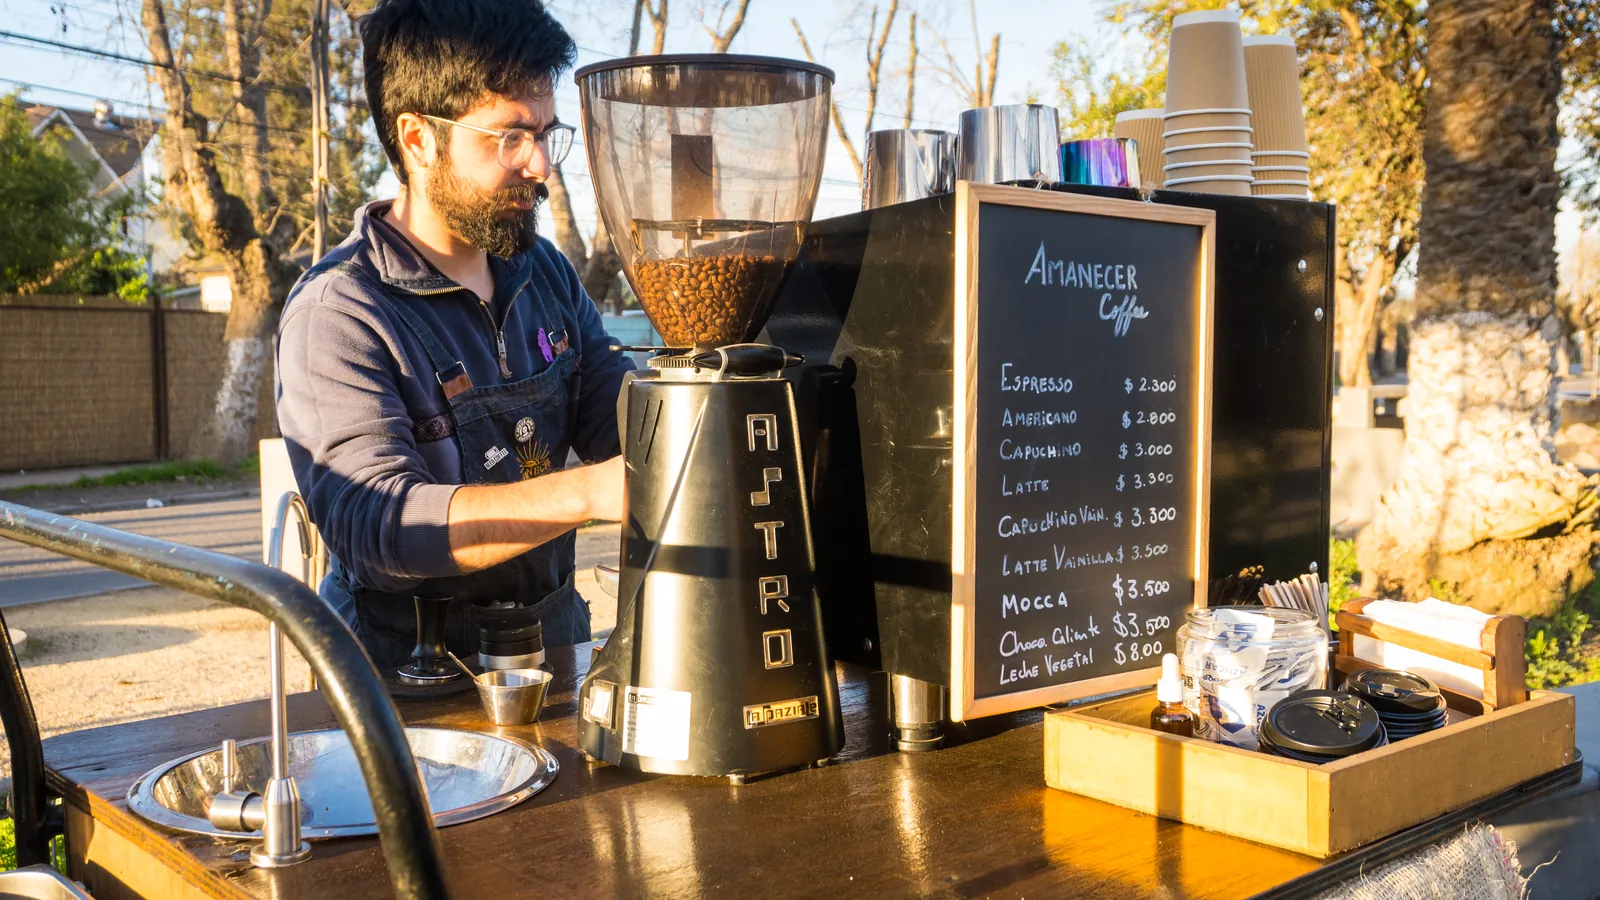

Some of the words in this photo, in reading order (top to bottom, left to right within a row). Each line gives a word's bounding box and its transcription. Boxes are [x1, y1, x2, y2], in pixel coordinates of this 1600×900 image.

[1024, 240, 1138, 290] AMANECER
[1098, 293, 1149, 337] Coffee
[1001, 363, 1073, 393] ESPRESSO
[1002, 474, 1050, 496] LATTE
[1002, 554, 1048, 576] LATTE
[1002, 592, 1068, 619] MOCCA
